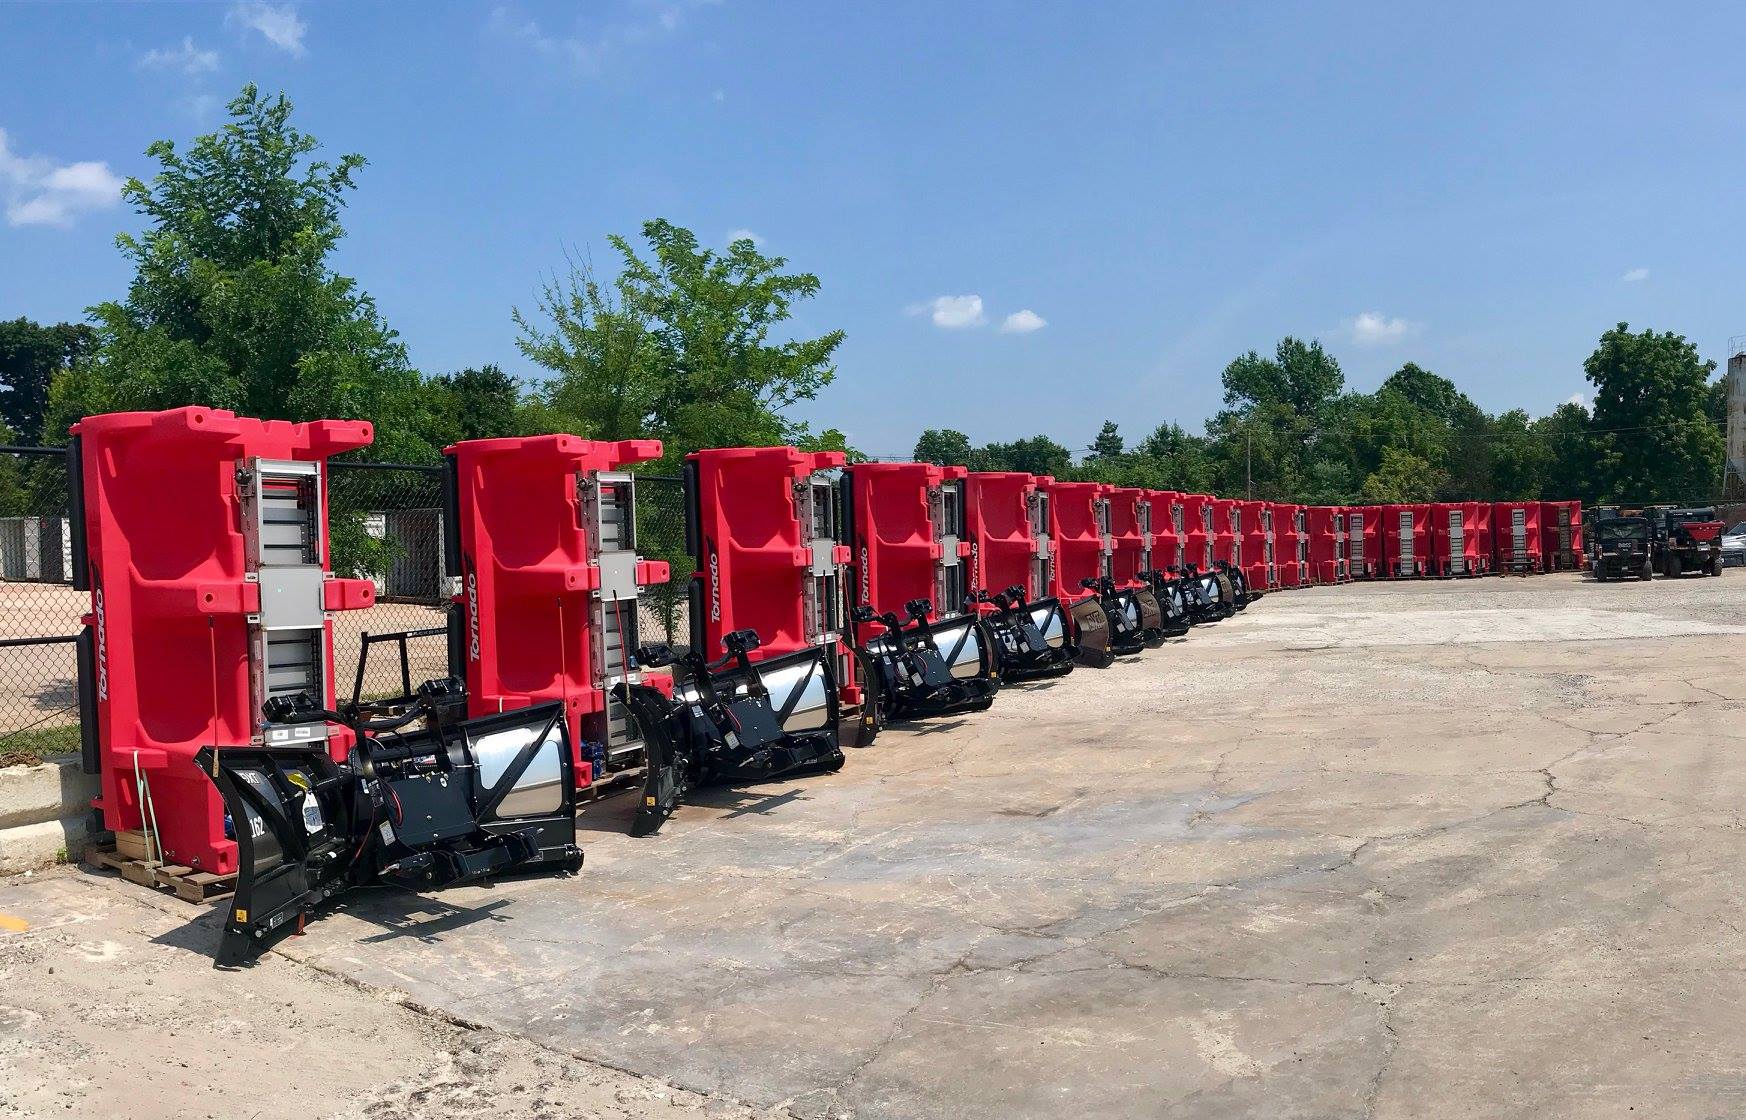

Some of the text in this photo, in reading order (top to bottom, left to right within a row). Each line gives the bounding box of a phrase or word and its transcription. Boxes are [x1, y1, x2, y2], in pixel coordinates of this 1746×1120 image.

[709, 553, 720, 623] Tornado
[860, 547, 870, 605] Tornado
[96, 588, 108, 703] Tornado
[467, 573, 480, 662] Tornado
